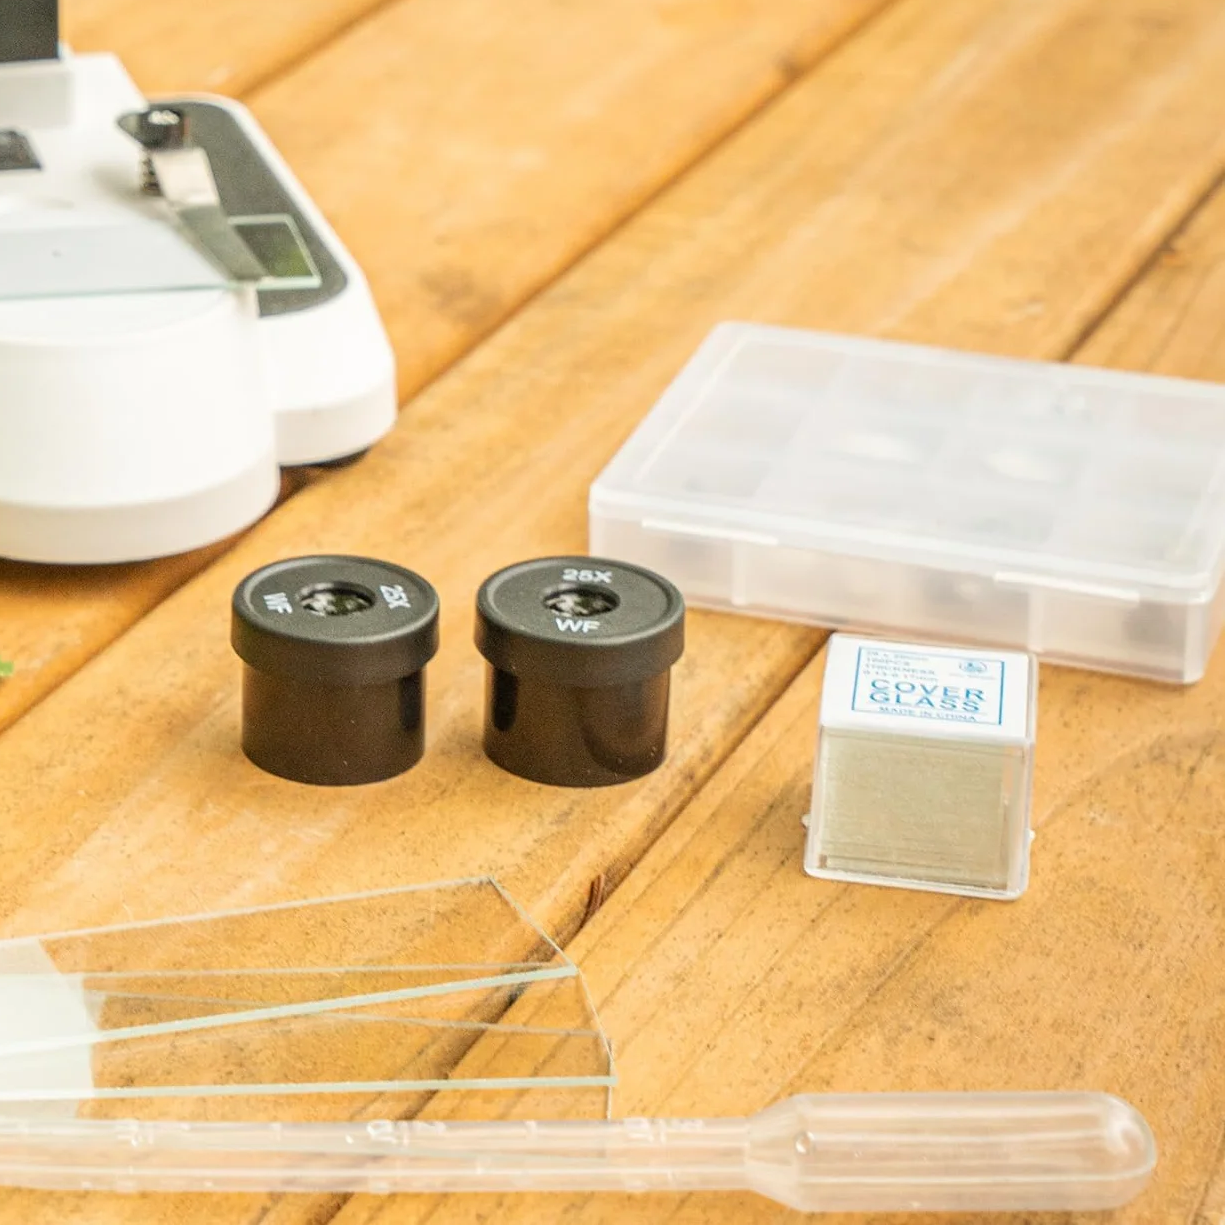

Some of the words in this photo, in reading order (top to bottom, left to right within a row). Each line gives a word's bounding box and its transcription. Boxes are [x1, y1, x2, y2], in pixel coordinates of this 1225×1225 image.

[562, 568, 613, 584] 25X
[263, 592, 293, 614] WF
[555, 618, 601, 634] WF
[870, 678, 986, 702] COVER
[869, 690, 981, 713] GLASS
[878, 706, 915, 718] MADE
[919, 711, 933, 719] IN
[936, 712, 977, 723] CHINA
